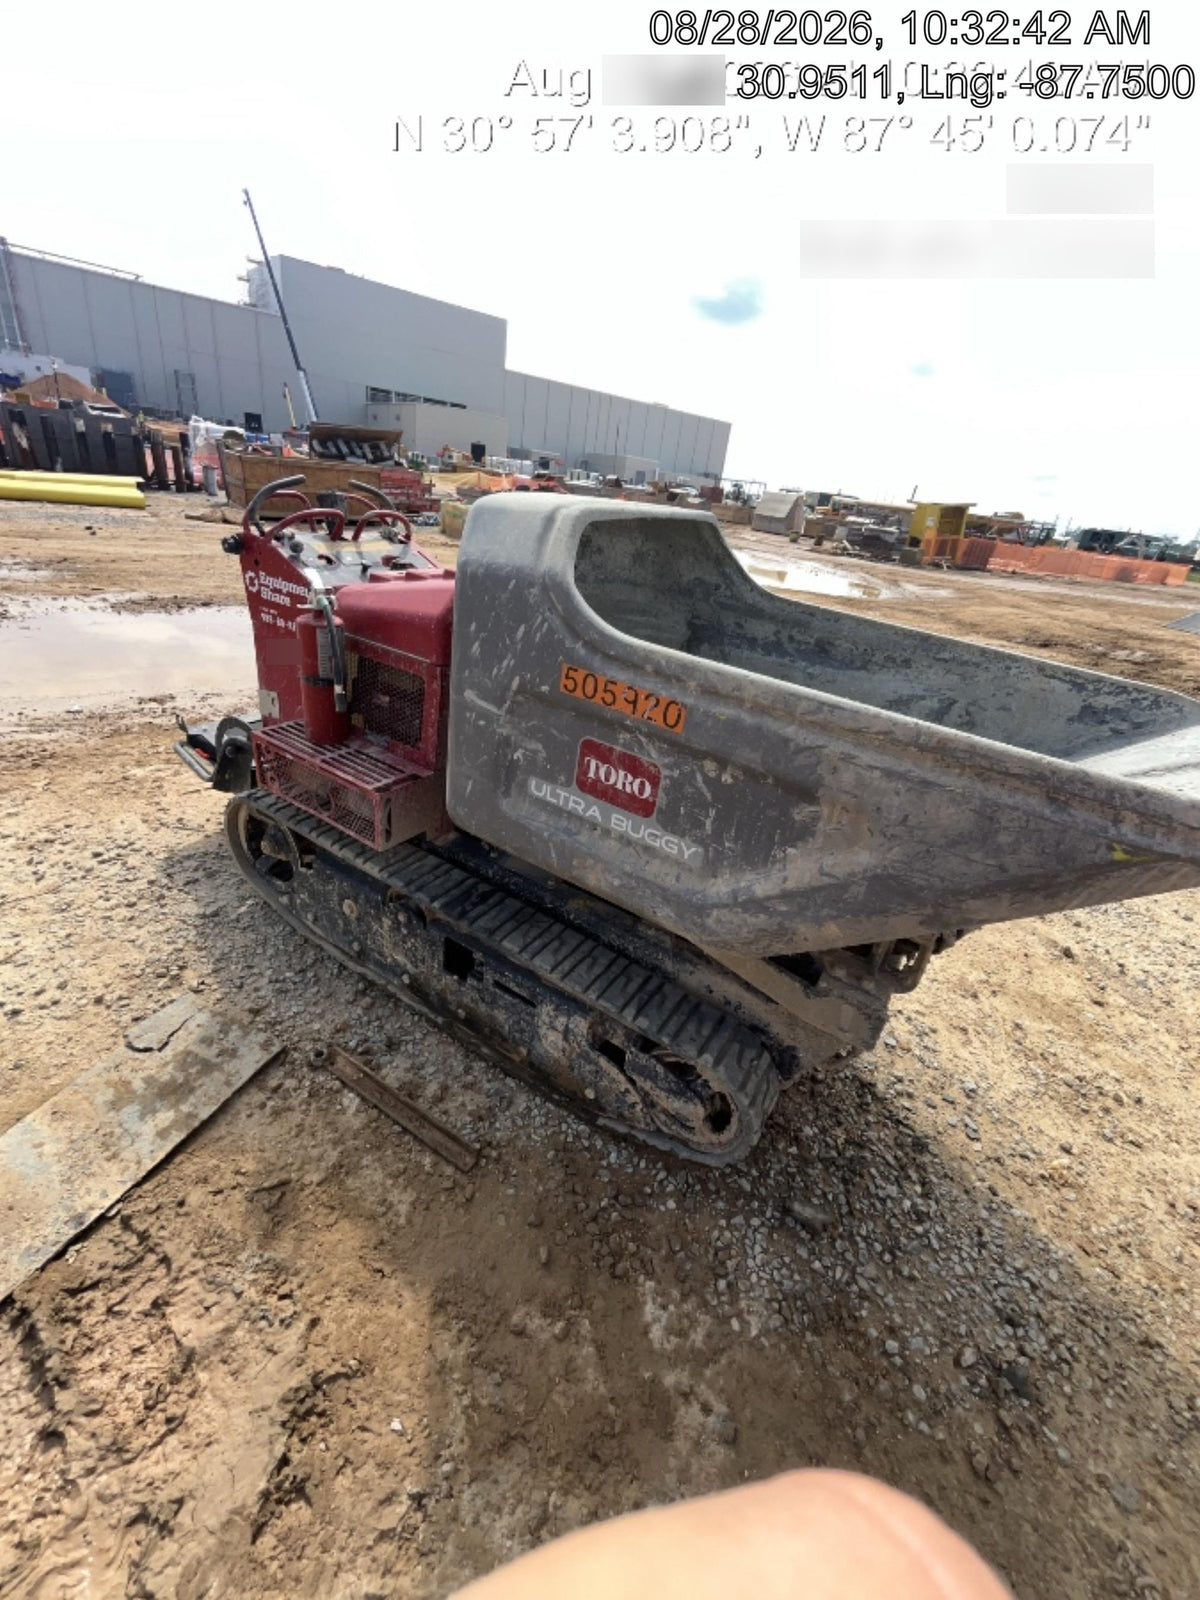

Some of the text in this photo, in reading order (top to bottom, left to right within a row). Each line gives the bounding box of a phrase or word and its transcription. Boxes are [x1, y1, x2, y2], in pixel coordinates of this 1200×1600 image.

[562, 666, 683, 729] 505920
[584, 756, 652, 800] TORO
[530, 778, 698, 859] ULTRA BUGGY
